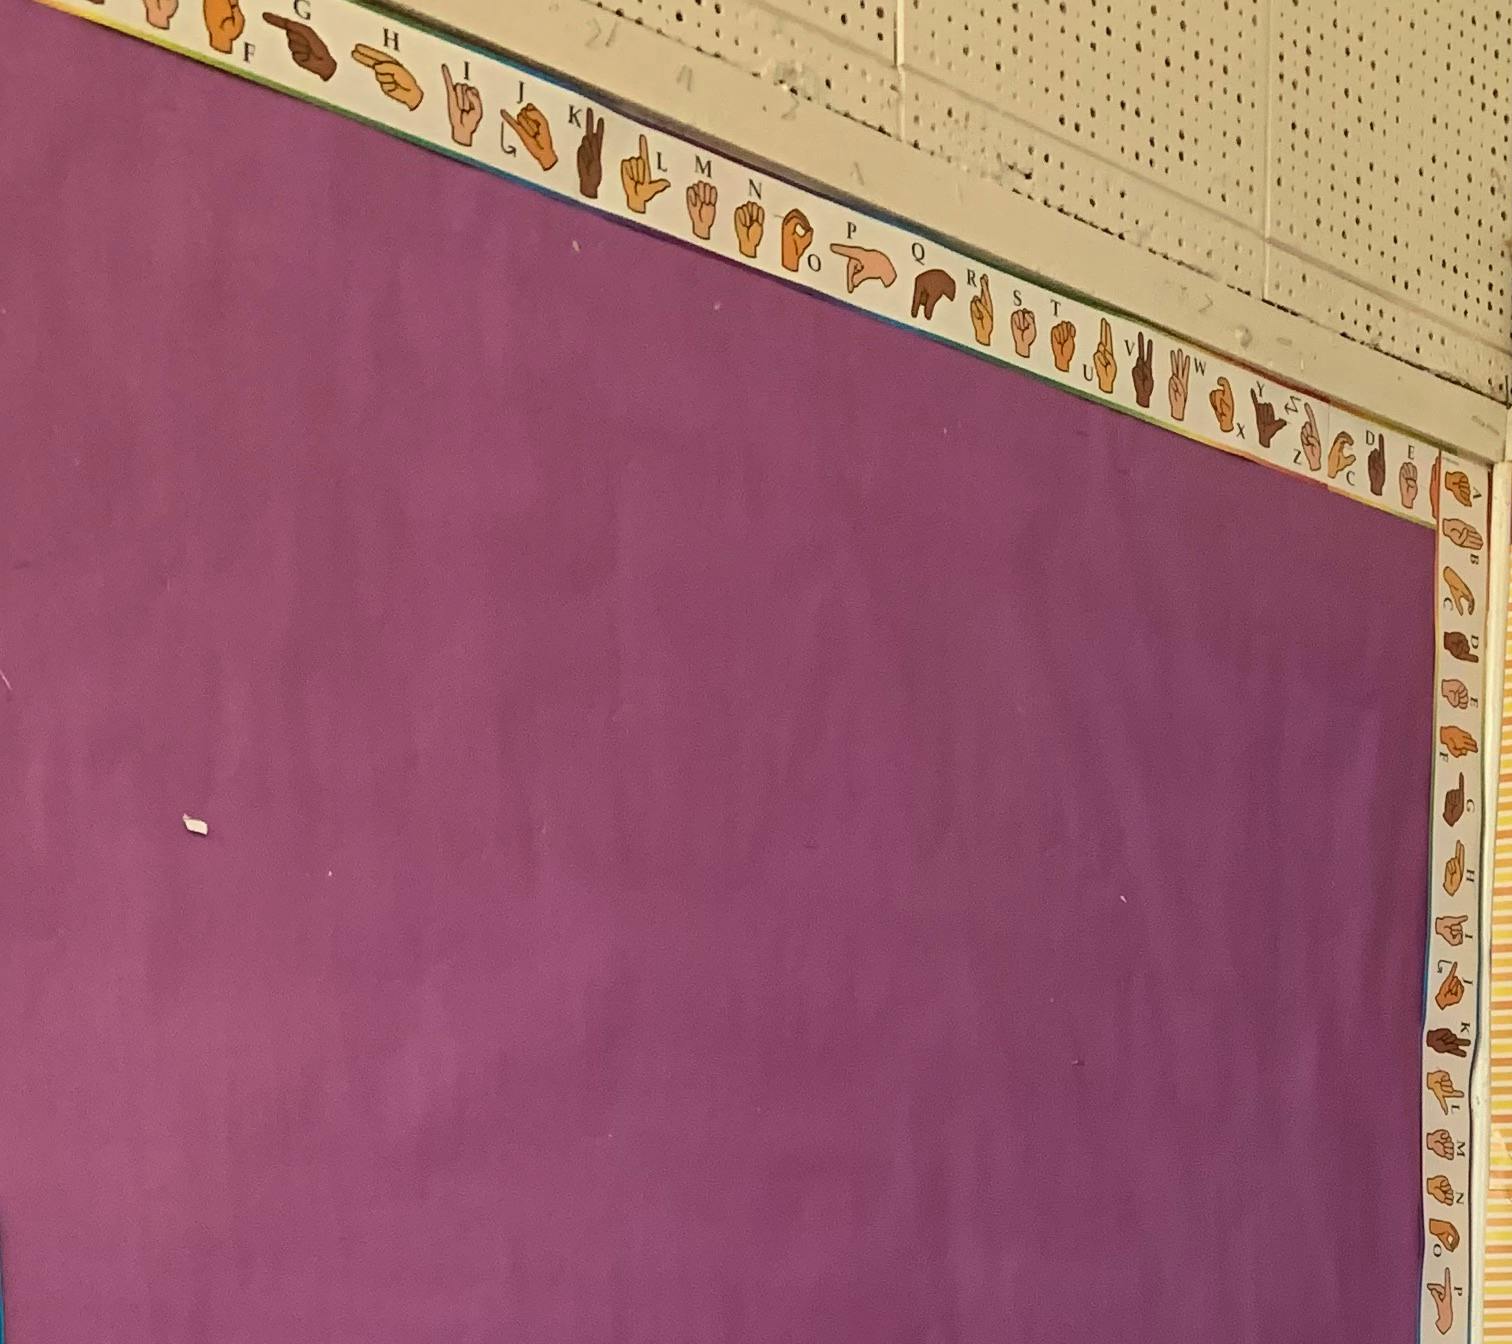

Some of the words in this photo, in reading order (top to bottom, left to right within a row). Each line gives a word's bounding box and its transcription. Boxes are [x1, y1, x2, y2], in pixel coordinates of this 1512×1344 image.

[383, 28, 400, 51] H
[569, 106, 580, 127] K
[656, 152, 668, 171] L
[694, 156, 712, 177] M
[749, 180, 762, 199] N
[807, 254, 821, 272] O
